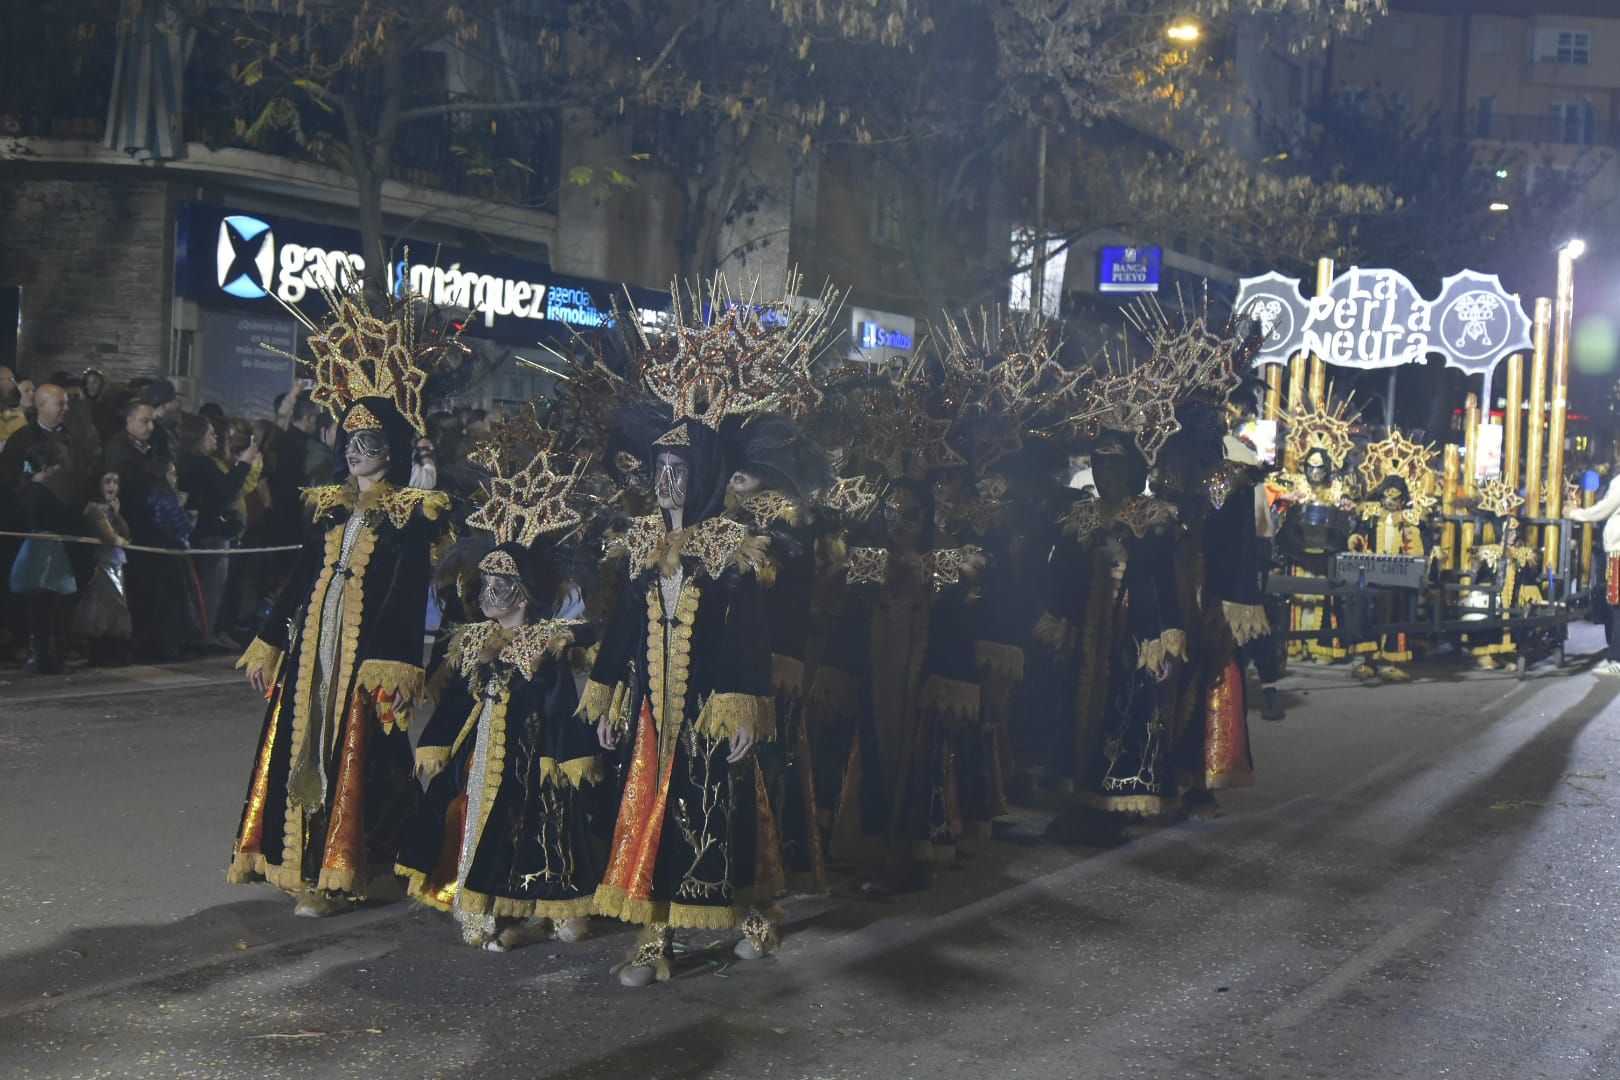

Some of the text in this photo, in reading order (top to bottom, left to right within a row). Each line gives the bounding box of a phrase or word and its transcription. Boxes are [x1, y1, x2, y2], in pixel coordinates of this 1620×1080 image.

[1112, 263, 1147, 273] BANCA
[1112, 272, 1146, 282] PUEYO
[277, 243, 394, 303] garc
[410, 263, 545, 327] márquez
[1350, 266, 1398, 300] La
[548, 286, 590, 308] agencia
